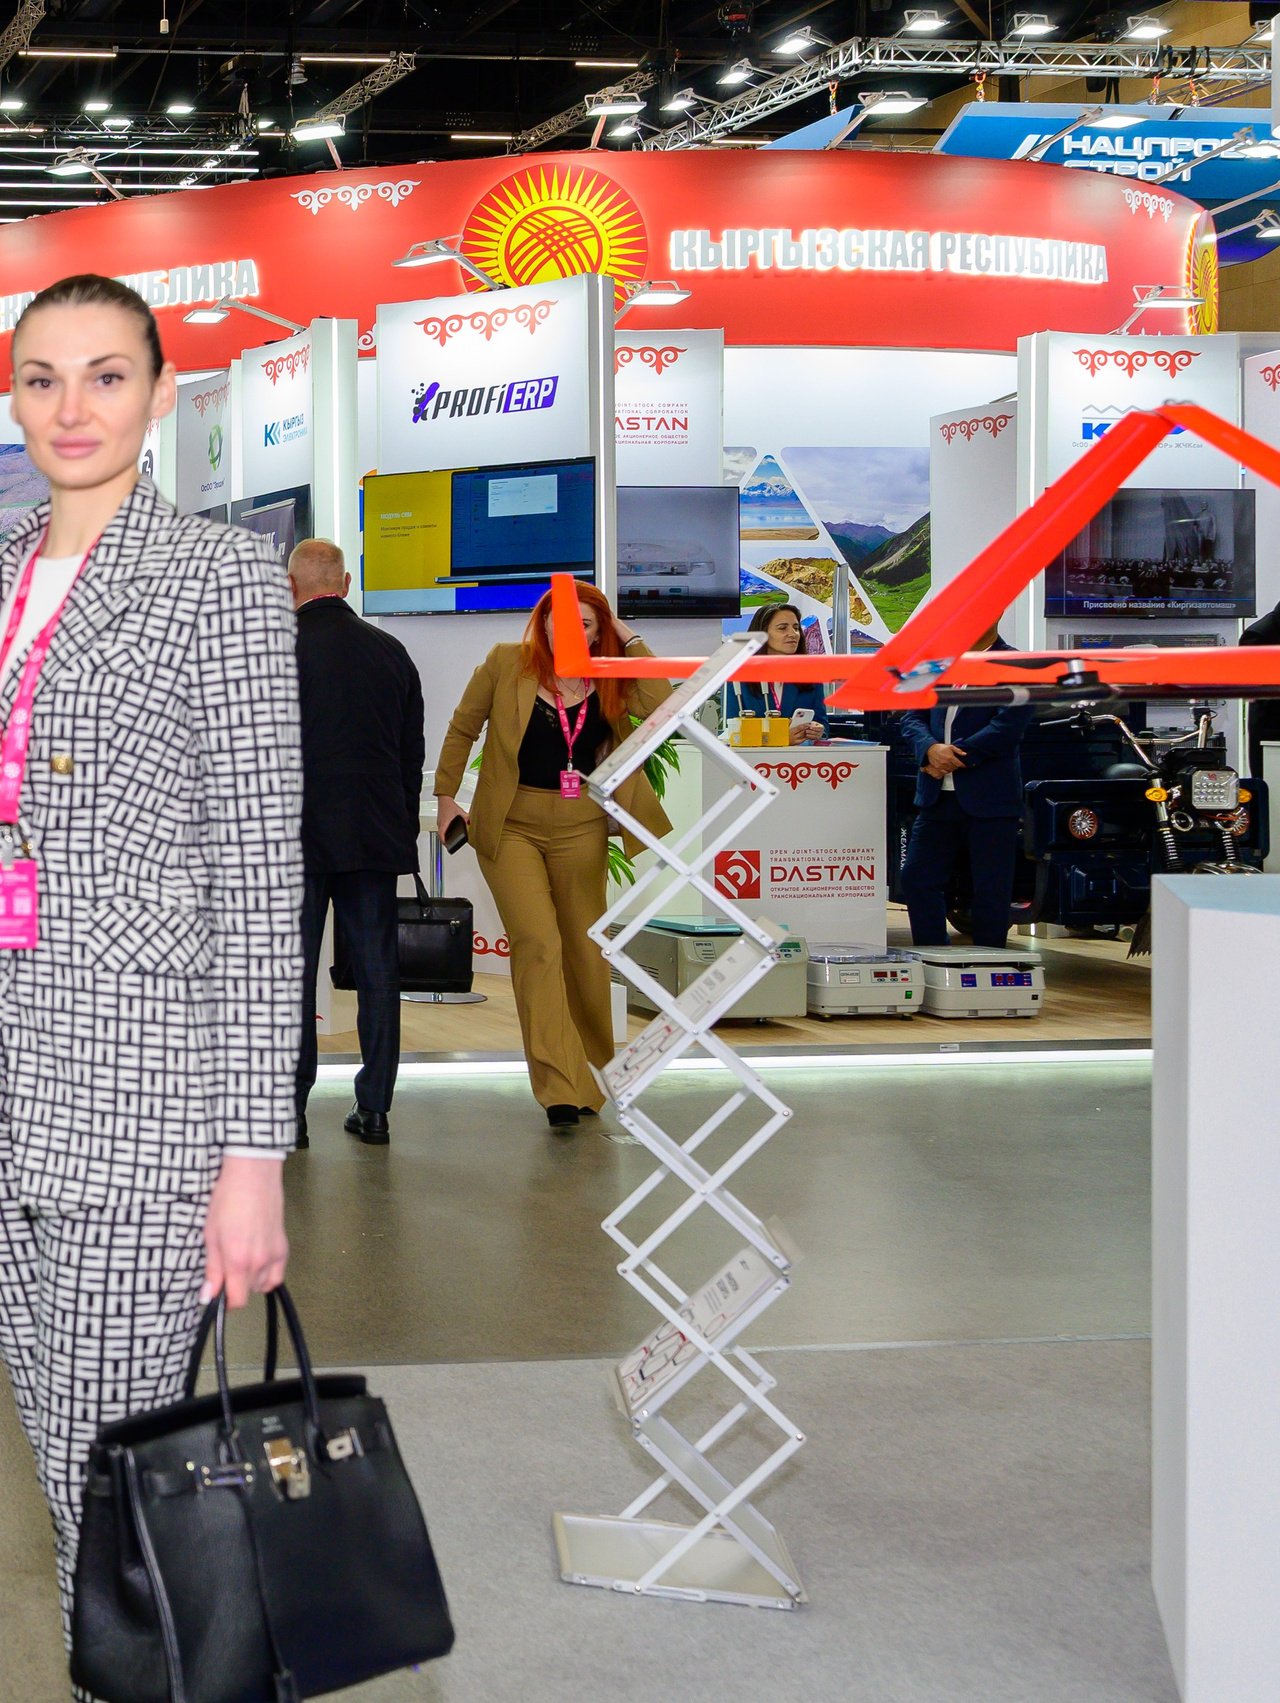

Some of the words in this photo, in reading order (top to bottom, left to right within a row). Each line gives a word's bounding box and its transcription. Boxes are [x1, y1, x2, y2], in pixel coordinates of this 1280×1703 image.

[1063, 135, 1280, 160] НАЦПРОЕ
[671, 228, 930, 270] КЫРГЫЗСКАЯ
[933, 231, 1109, 284] РЕСПУБЛИКА
[111, 259, 258, 308] УБЛИКА
[615, 417, 688, 430] ASTAN
[1083, 600, 1127, 610] Присвоено
[1166, 600, 1237, 610] «Киргизавтомаш»
[770, 864, 875, 882] DASTAN
